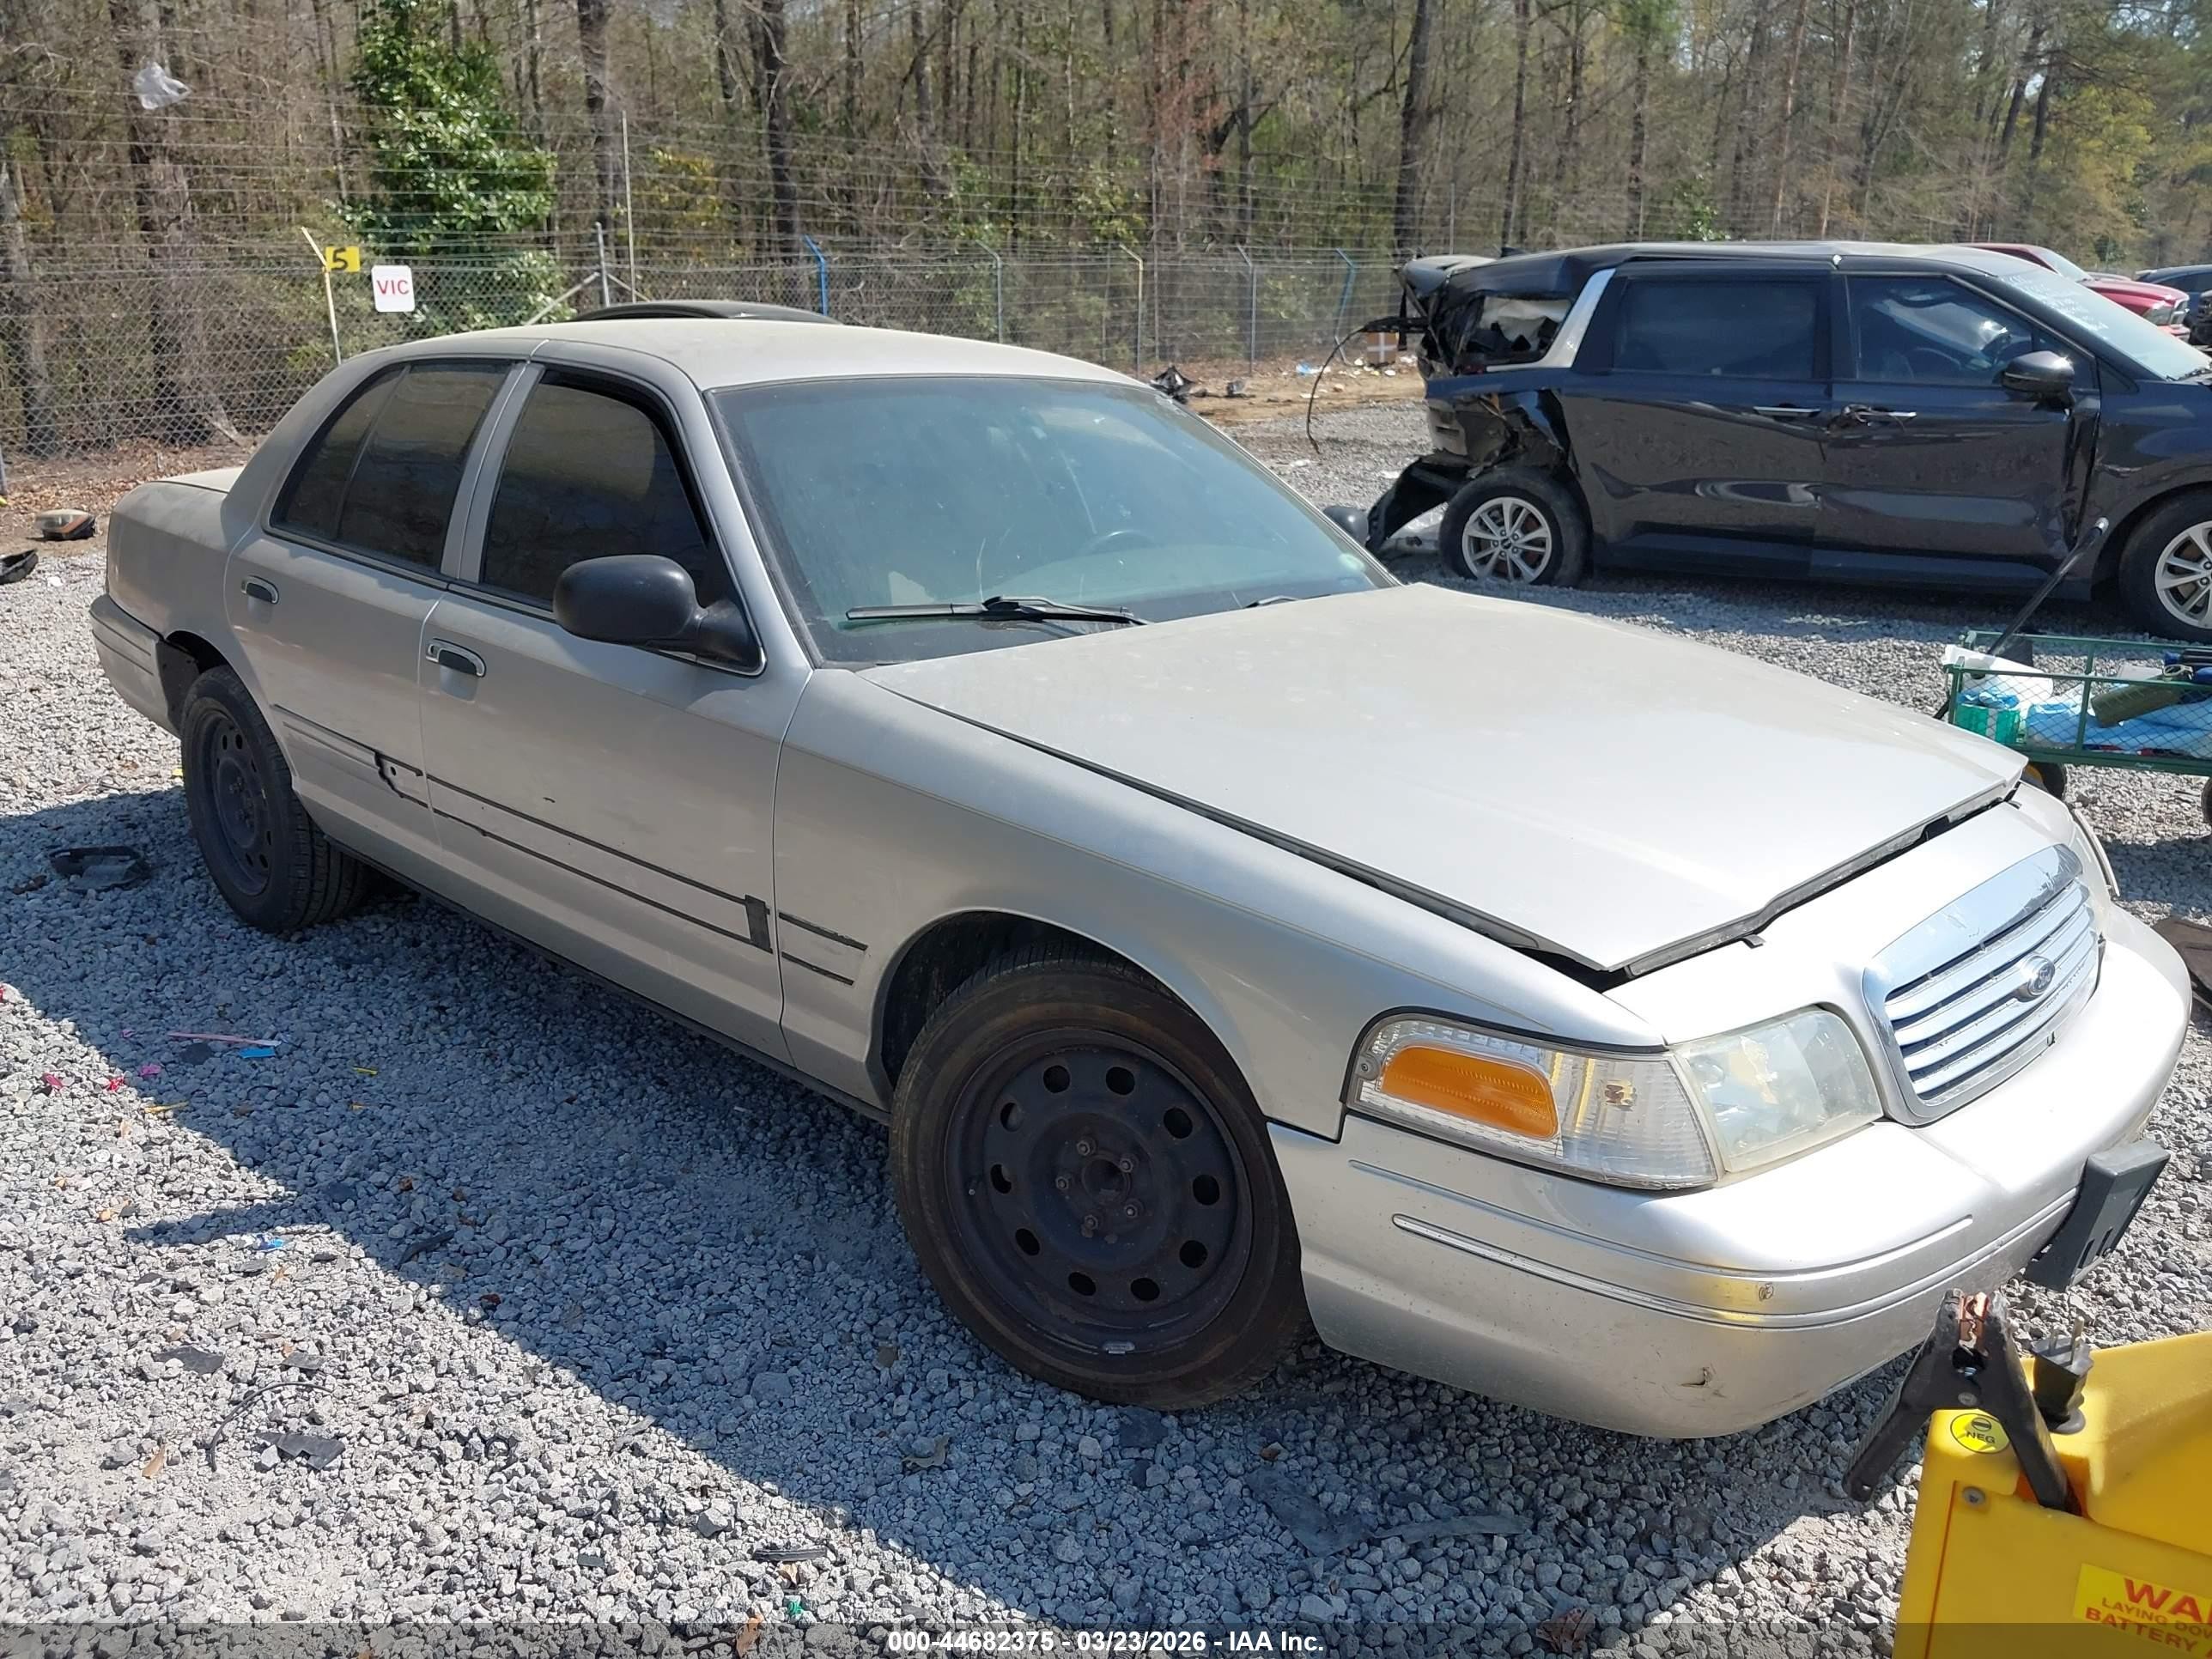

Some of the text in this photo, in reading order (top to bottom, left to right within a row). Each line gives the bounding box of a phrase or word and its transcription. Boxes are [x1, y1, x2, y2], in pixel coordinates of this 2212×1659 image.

[331, 247, 349, 270] 5
[376, 279, 410, 295] VIC
[1966, 1431, 1996, 1443] NEG
[2101, 1597, 2168, 1626] LAYING
[2124, 1577, 2212, 1627] WA
[2085, 1607, 2198, 1652] BATTERY
